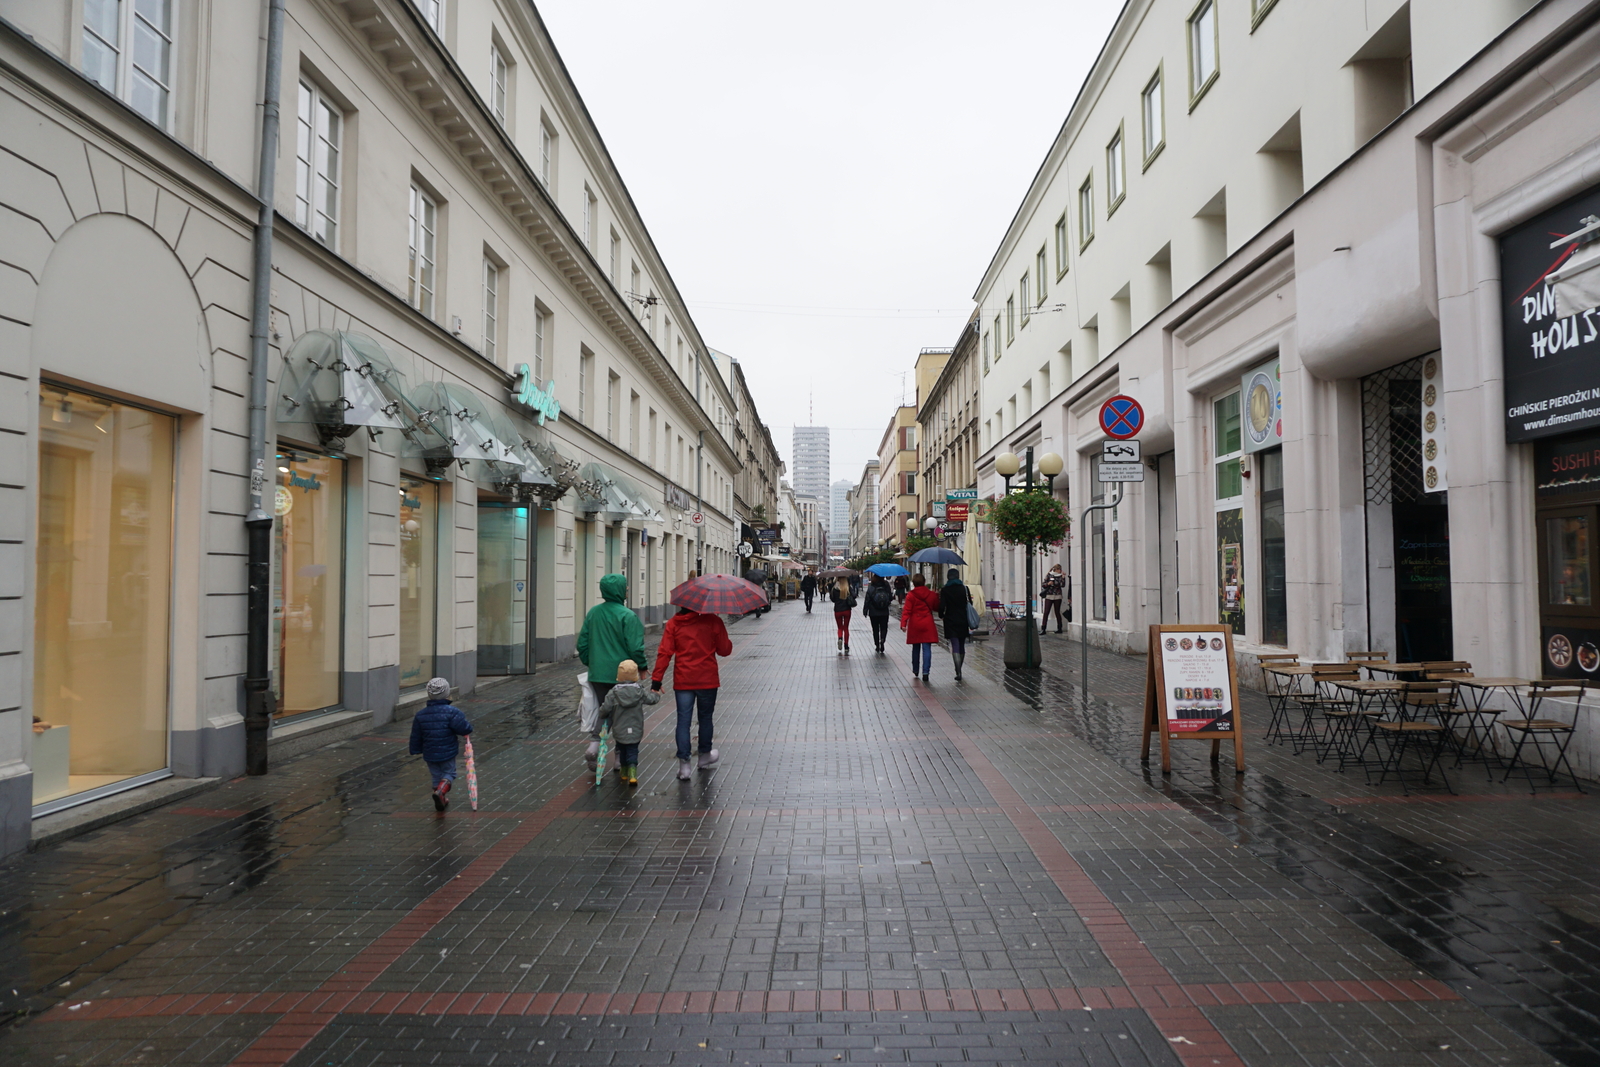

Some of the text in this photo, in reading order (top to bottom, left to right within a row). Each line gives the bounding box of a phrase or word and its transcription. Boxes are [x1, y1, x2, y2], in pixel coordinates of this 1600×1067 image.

[1530, 307, 1600, 359] HOUS
[1508, 388, 1600, 417] CHIŃSKIE PIEROŻKI N
[1552, 452, 1590, 472] SUSHI
